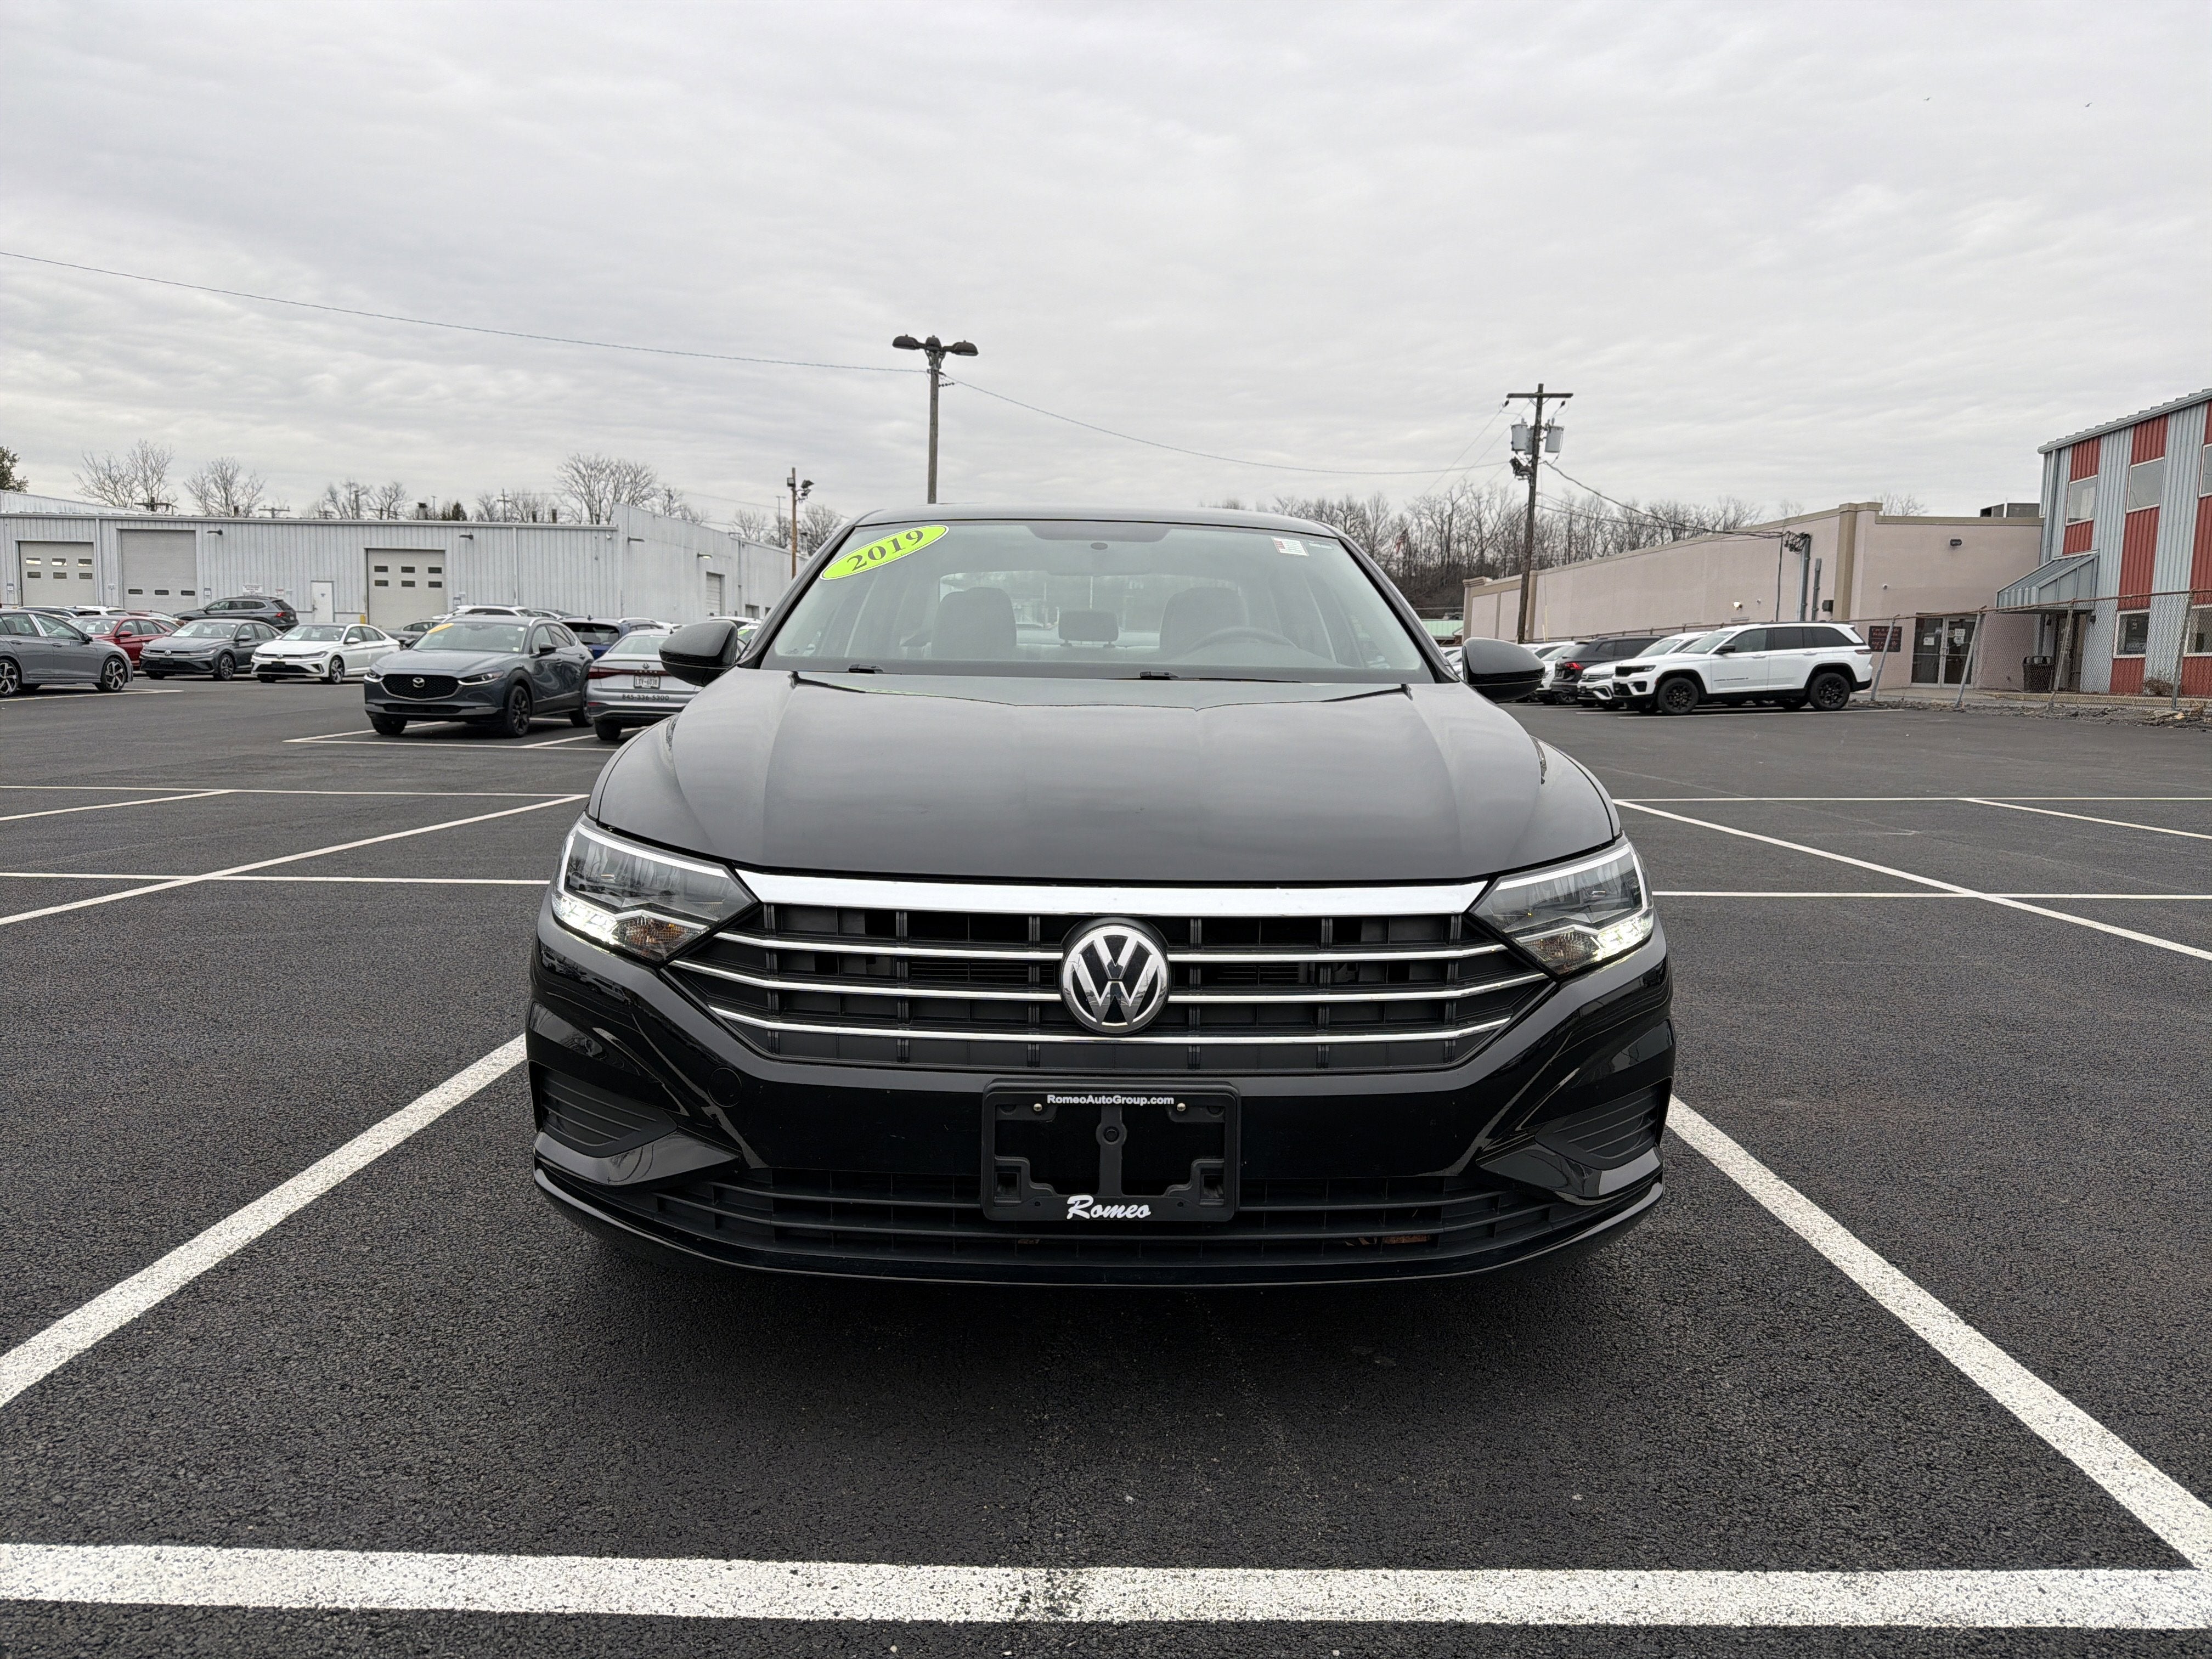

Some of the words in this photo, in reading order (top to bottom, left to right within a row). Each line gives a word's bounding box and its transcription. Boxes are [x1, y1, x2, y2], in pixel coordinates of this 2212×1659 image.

[847, 530, 924, 572] 2019
[1047, 1094, 1175, 1105] RomeoAutoGroup.com
[1066, 1195, 1152, 1219] Romeo
